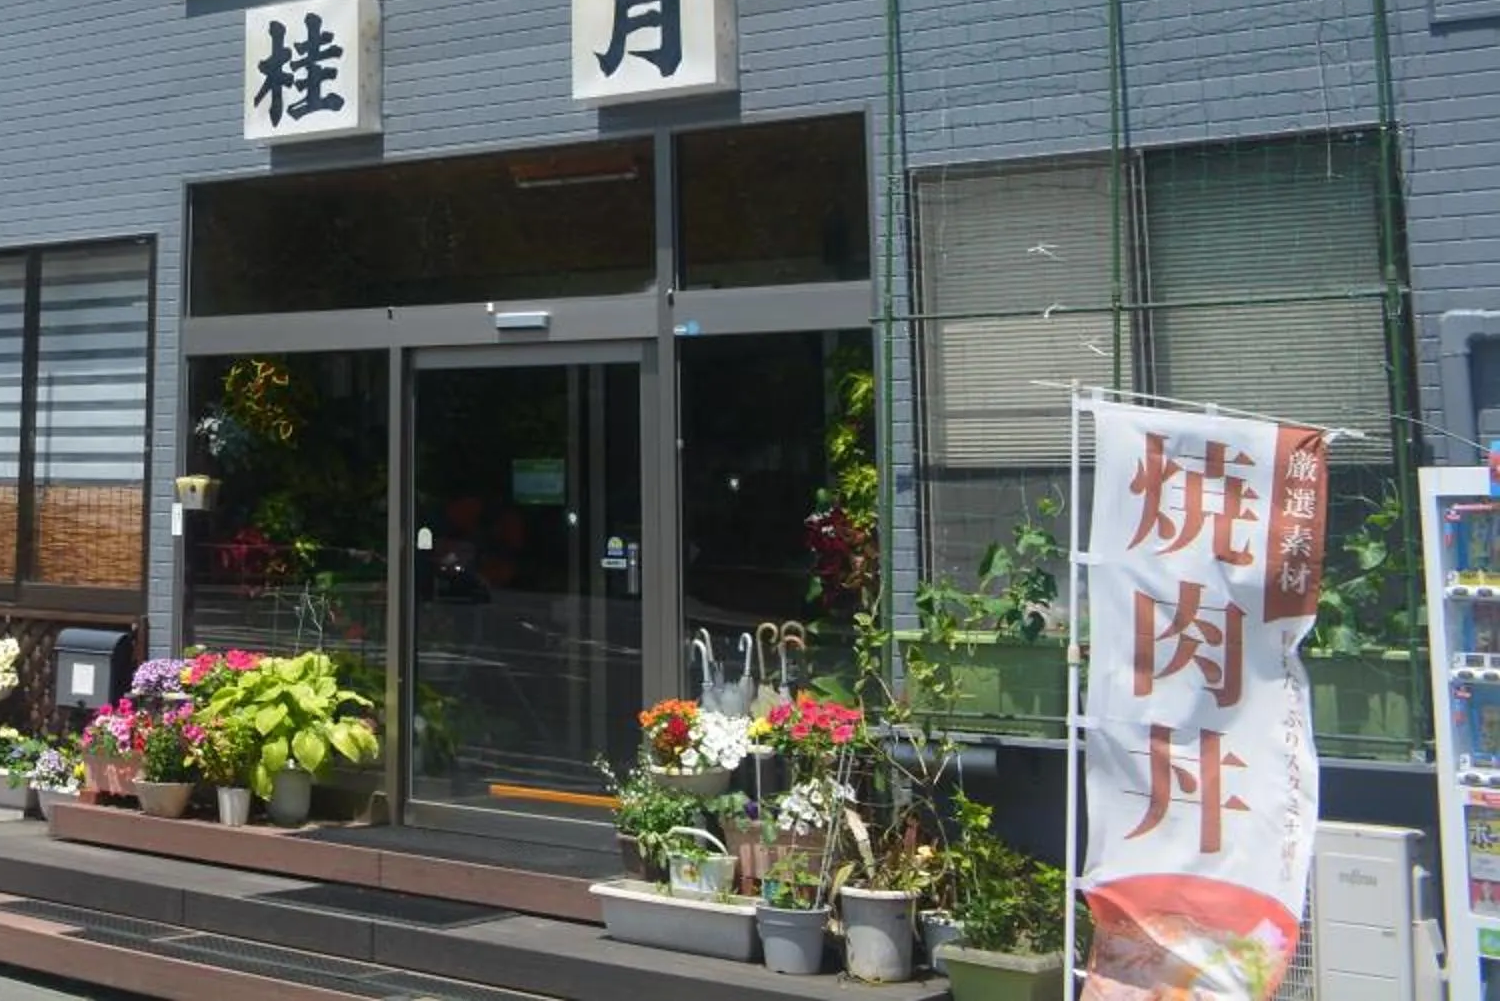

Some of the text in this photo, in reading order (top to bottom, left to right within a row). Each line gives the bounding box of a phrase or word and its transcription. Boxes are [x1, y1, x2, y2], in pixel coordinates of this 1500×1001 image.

[254, 12, 345, 128] 桂
[1279, 449, 1319, 595] 厳選素材
[1123, 431, 1262, 855] 焼肉丼
